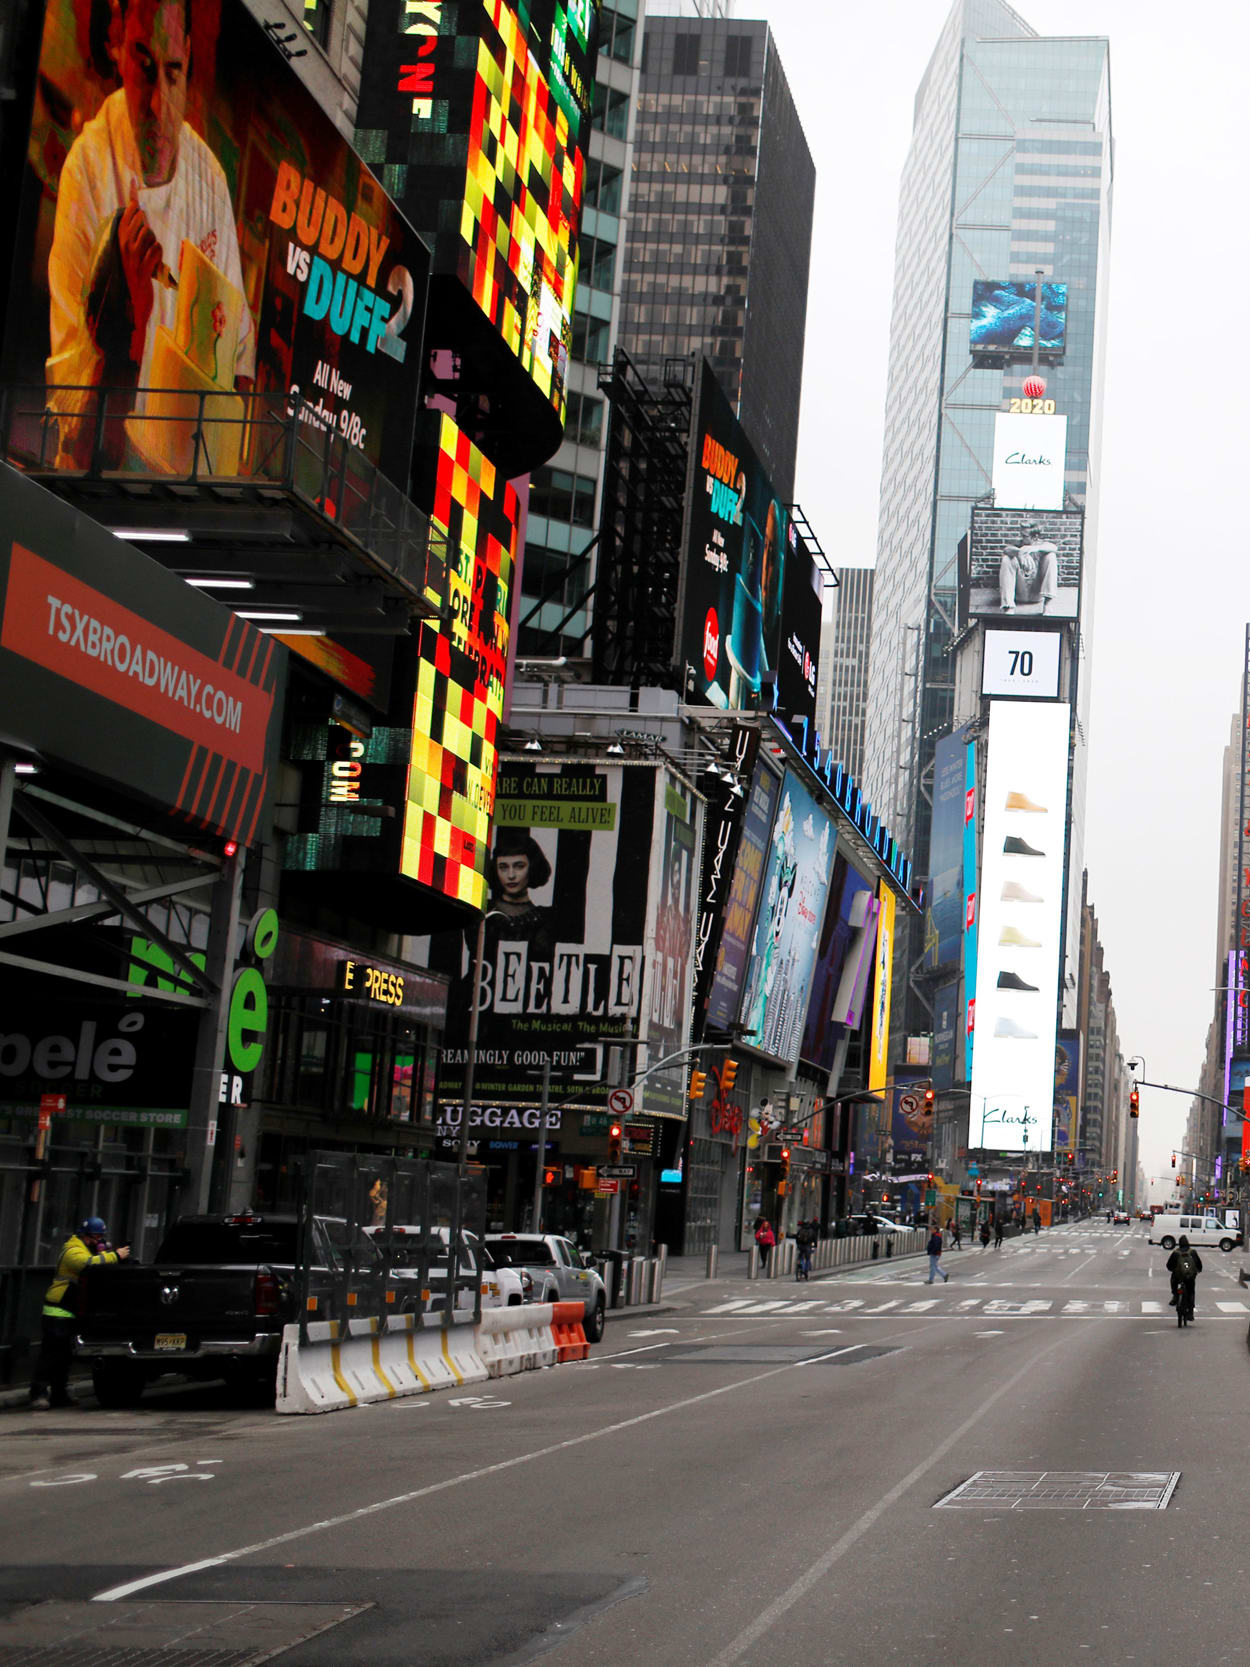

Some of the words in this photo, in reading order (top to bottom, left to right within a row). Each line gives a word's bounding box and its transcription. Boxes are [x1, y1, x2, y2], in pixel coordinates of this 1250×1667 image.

[270, 160, 389, 288] BUDDY
[304, 255, 391, 354] DUFF
[377, 264, 414, 363] 2
[313, 360, 329, 394] All
[330, 367, 352, 401] New
[1010, 399, 1056, 414] 2020
[339, 409, 367, 449] 9/8c
[702, 432, 739, 489] BUDDY
[1005, 451, 1051, 466] Clarks
[733, 471, 746, 527] 2
[47, 595, 243, 733] TSXBROADWAY.COM
[1008, 650, 1033, 676] 70
[622, 731, 664, 743] LAMAR
[523, 778, 548, 794] CAN
[552, 778, 602, 795] REALLY
[502, 804, 526, 821] YOU
[531, 805, 563, 823] FEEL
[568, 807, 612, 825] ALIVE!
[468, 950, 635, 1015] BEETLE
[514, 1050, 548, 1065] GOOD
[84, 1110, 138, 1123] SOCCER
[139, 1112, 182, 1124] STORE
[983, 1108, 1038, 1125] Clarks
